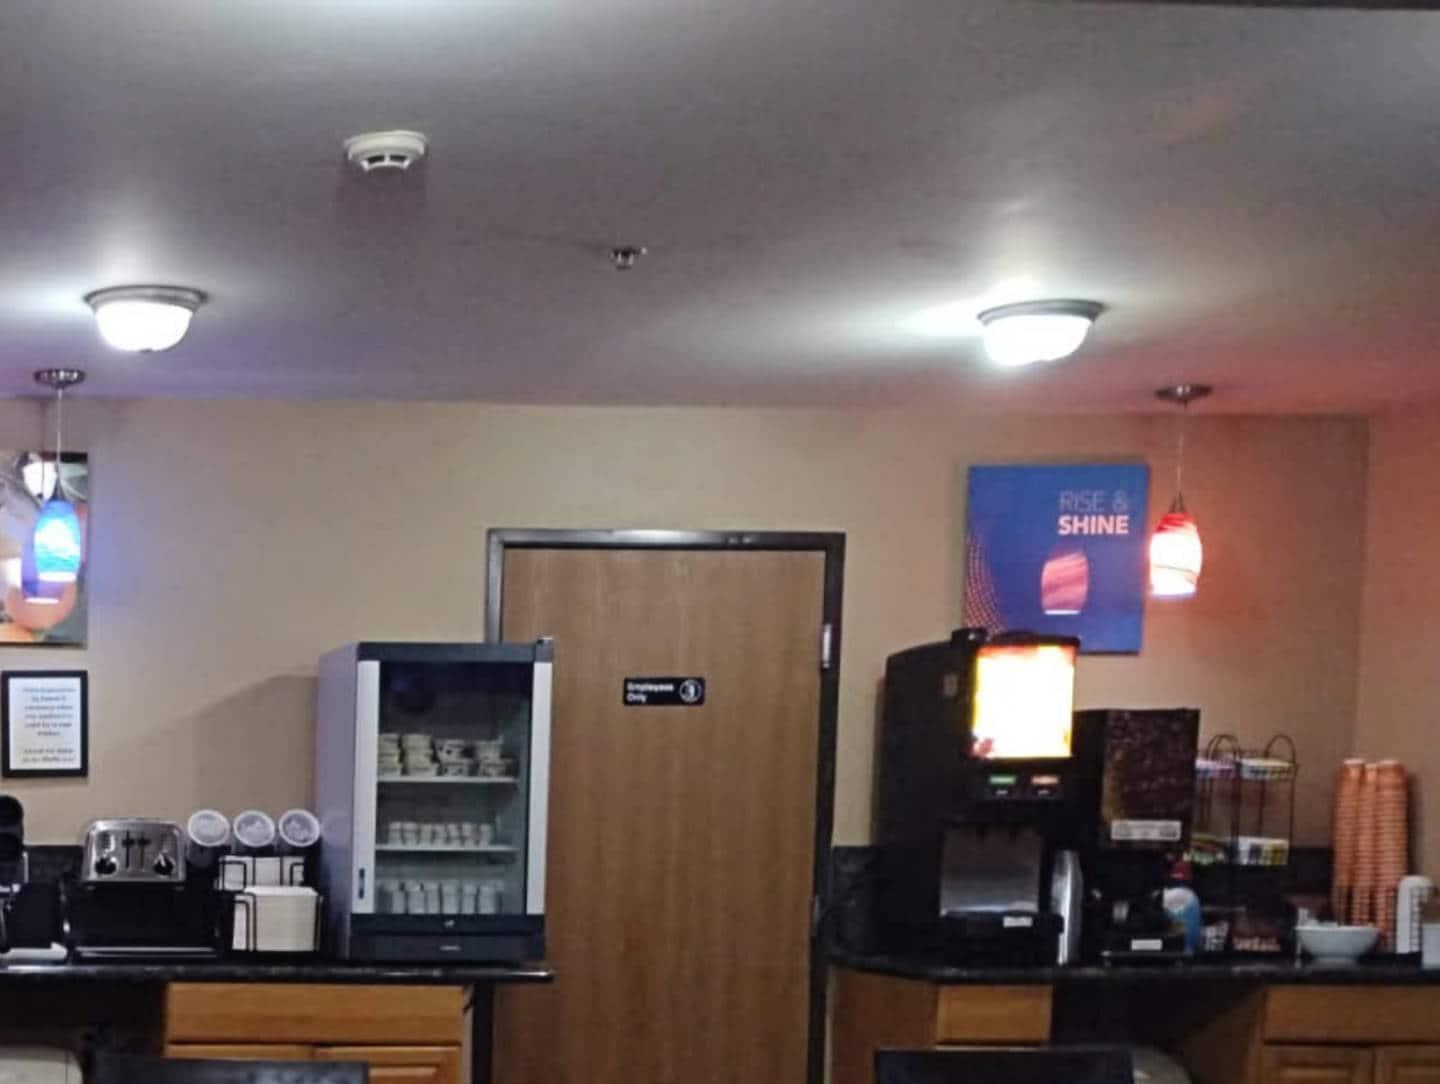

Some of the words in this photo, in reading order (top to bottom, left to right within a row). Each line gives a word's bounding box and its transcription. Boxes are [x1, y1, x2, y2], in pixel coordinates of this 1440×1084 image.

[1059, 490, 1105, 513] RISE
[1111, 489, 1129, 513] &
[1058, 515, 1129, 535] SHINE
